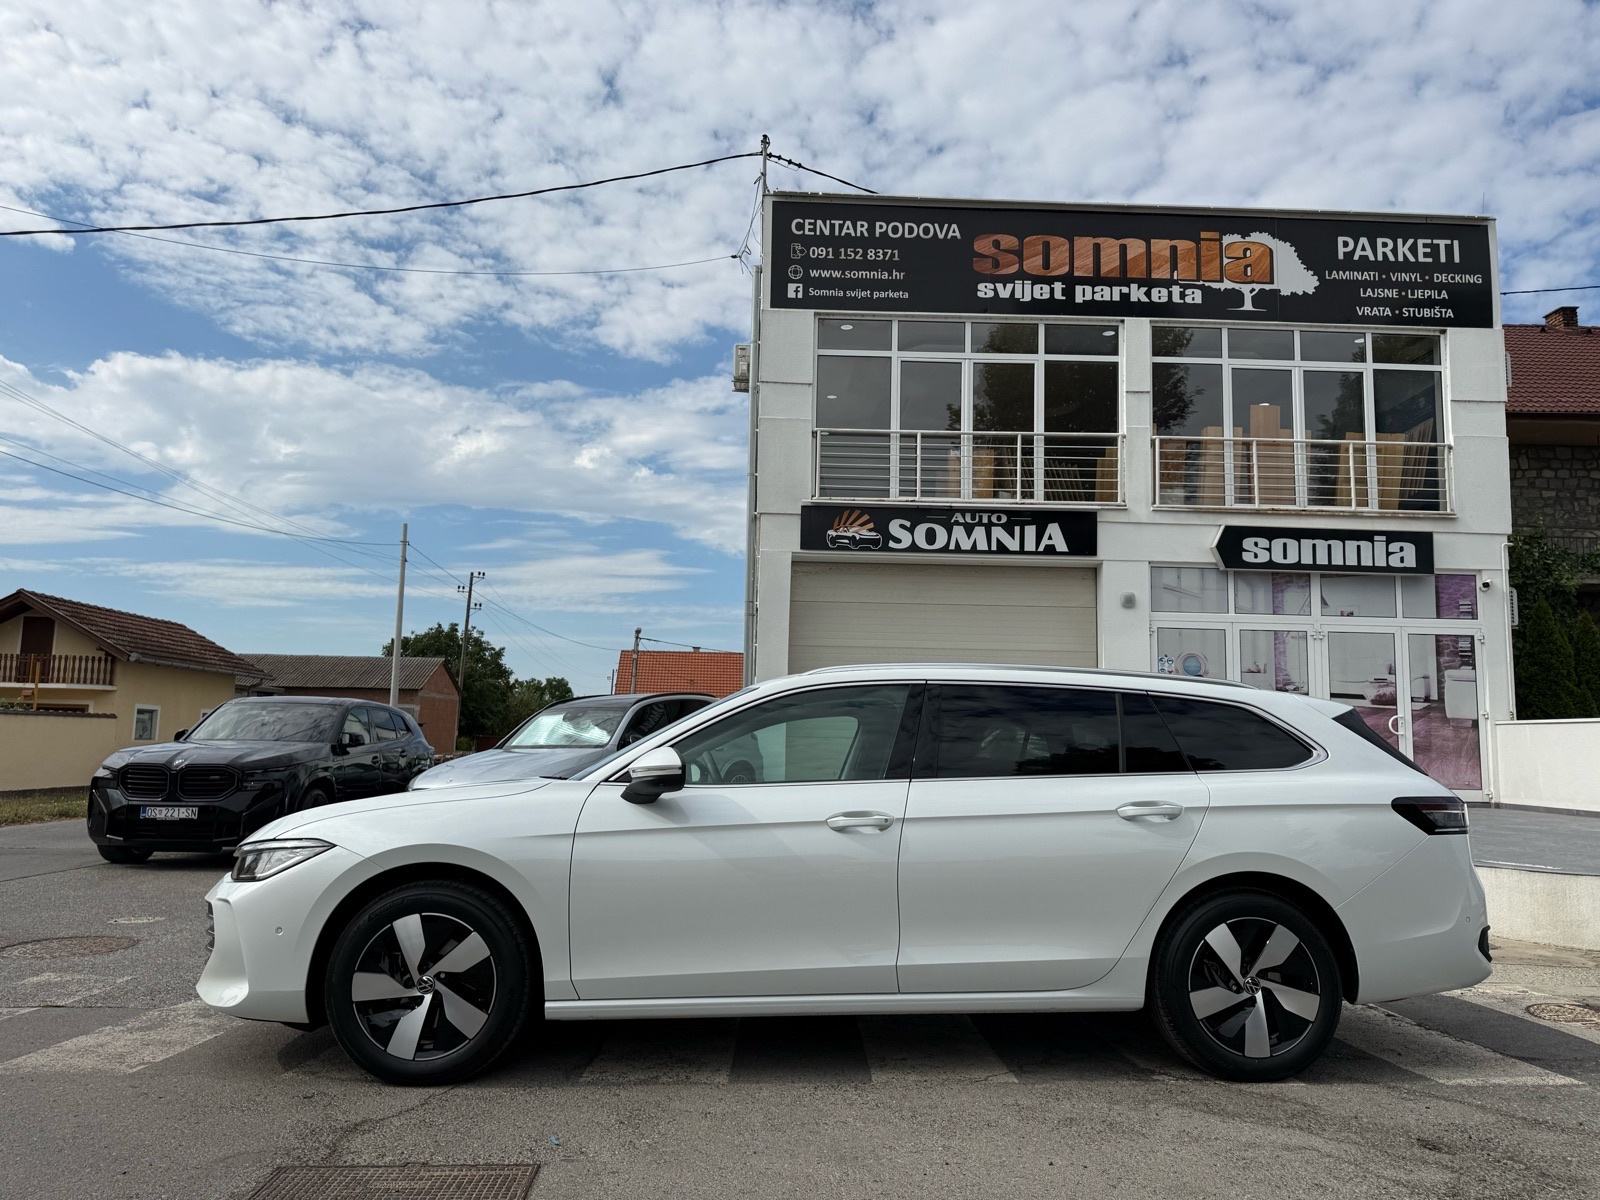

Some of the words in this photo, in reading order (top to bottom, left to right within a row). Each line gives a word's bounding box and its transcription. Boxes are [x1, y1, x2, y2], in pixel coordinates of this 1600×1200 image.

[790, 218, 869, 238] CENTAR
[875, 221, 962, 240] PODOVA
[809, 246, 835, 259] 091
[838, 247, 863, 260] 152
[867, 247, 900, 261] 8371
[1337, 236, 1461, 263] PARKETI
[972, 231, 1275, 284] somnia
[809, 268, 906, 280] www.somnia.hr
[1325, 270, 1379, 281] LAMINATI
[1389, 271, 1423, 282] VINYL
[1433, 273, 1483, 284] DECKING
[808, 287, 844, 298] Somnia
[846, 287, 871, 299] svijet
[873, 289, 909, 300] parketa
[976, 279, 1067, 302] svijet
[1074, 282, 1203, 304] parketa
[1360, 287, 1400, 298] LAJSNE
[1408, 288, 1449, 299] LJEPILA
[1356, 306, 1392, 317] VRATA
[1402, 306, 1455, 318] STUBIŠTA
[951, 512, 1007, 524] AUTO
[888, 518, 1069, 552] SOMNIA
[1241, 535, 1417, 568] somnia
